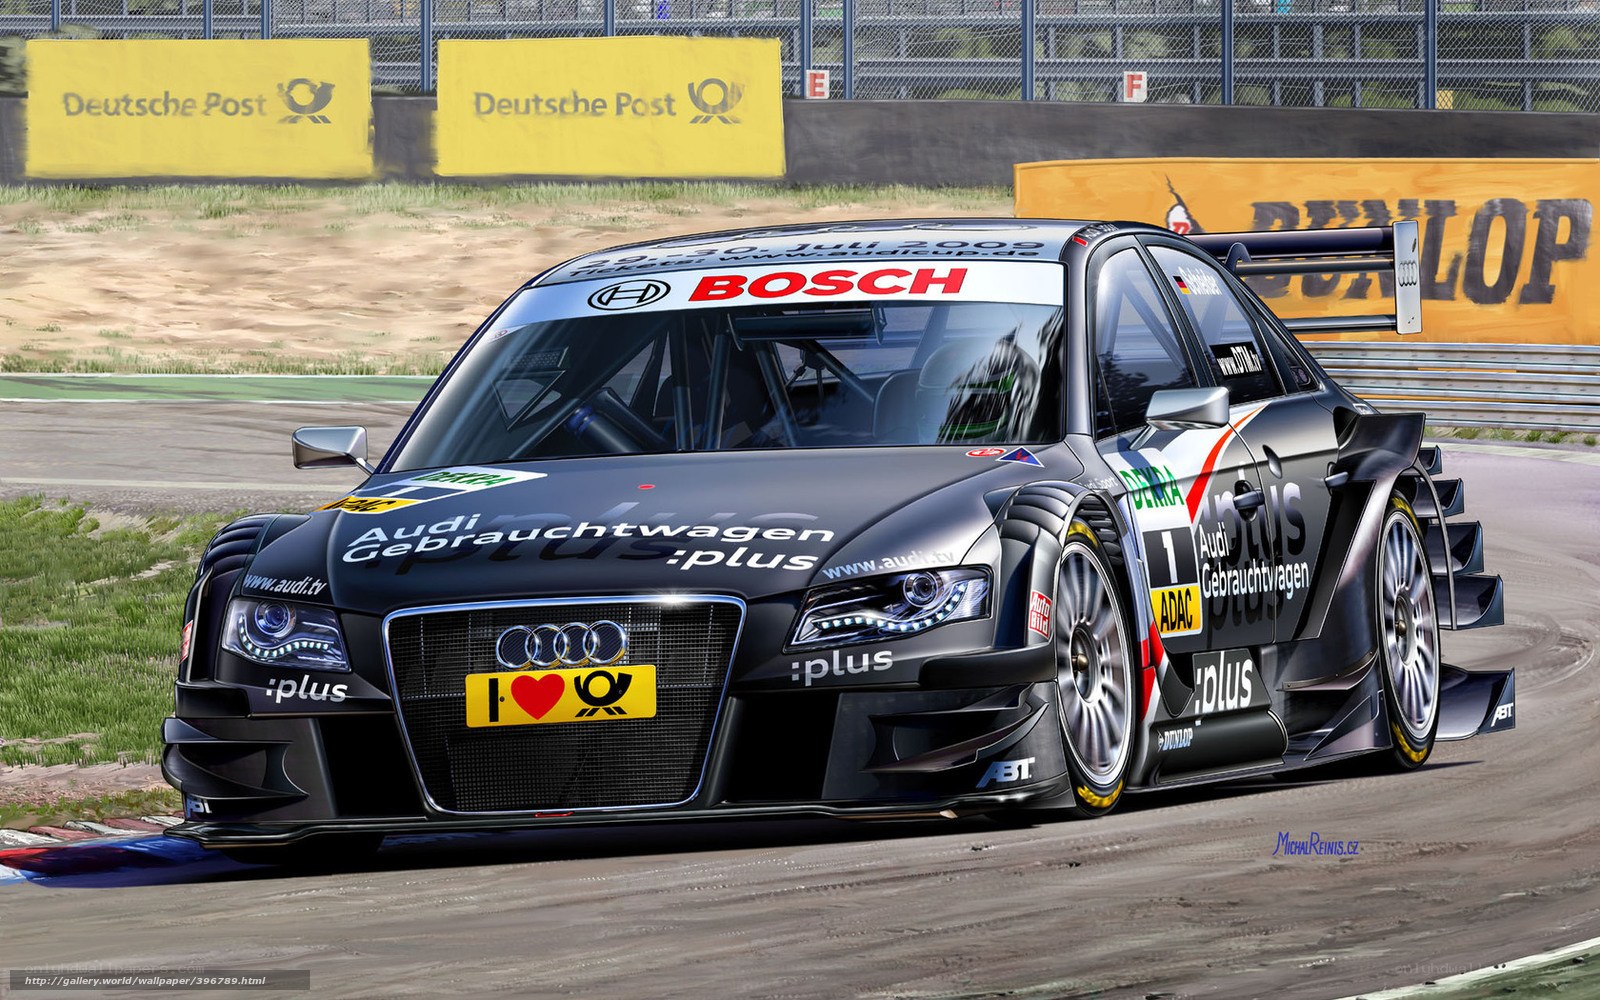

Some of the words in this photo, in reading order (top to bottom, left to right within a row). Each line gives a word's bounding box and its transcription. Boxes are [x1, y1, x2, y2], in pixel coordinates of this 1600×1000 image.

[809, 73, 825, 98] E
[1127, 74, 1143, 98] F
[62, 91, 197, 116] Deutsche
[203, 92, 268, 116] Post
[474, 90, 608, 117] Deutsche
[615, 92, 677, 116] Post
[719, 249, 1039, 261] www.audicup.de
[786, 241, 880, 253] Juli
[898, 240, 1045, 249] 2009
[688, 267, 967, 302] BOSCH
[1119, 465, 1185, 510] DEKRA
[342, 522, 835, 563] Gebrauchtwagen
[347, 513, 482, 548] Audi
[1199, 522, 1230, 559] Audi
[666, 547, 819, 571] :plus
[822, 551, 955, 579] www.audi.tv
[1161, 531, 1179, 584] 1
[243, 574, 327, 596] www.audi.tv
[1202, 558, 1310, 600] Gebrauchtwagen
[1030, 593, 1050, 618] Auto
[1160, 588, 1193, 632] ADAC
[1031, 611, 1049, 635] Bild
[792, 650, 893, 686] :plus
[266, 674, 348, 703] :plus
[488, 678, 499, 722] I
[1195, 651, 1254, 726] :plus
[1491, 702, 1514, 727] ABT
[1162, 728, 1193, 751] DUNLOP
[976, 756, 1036, 788] ABT
